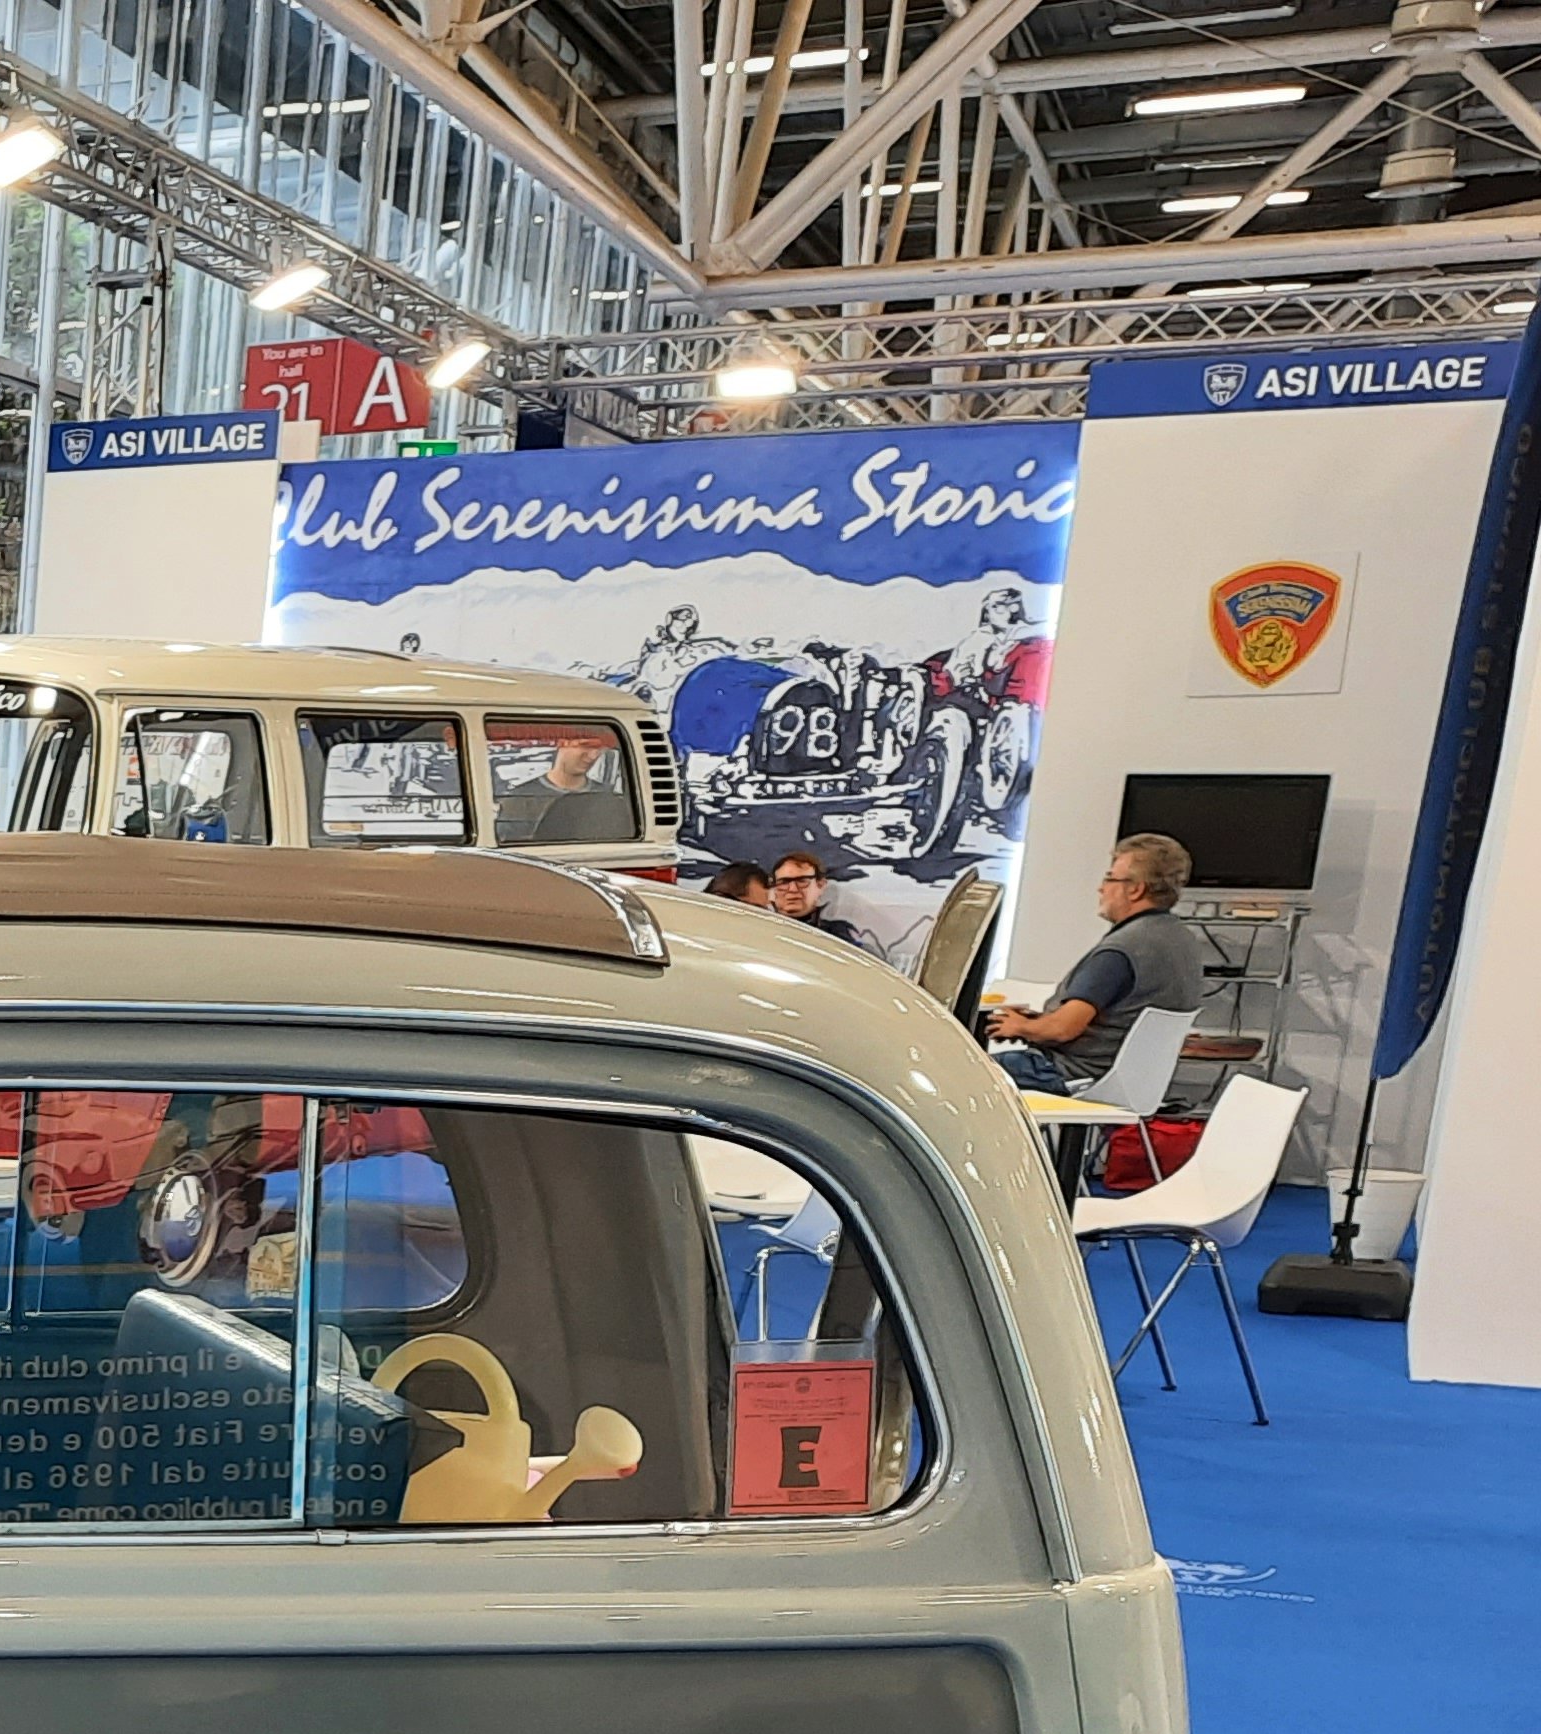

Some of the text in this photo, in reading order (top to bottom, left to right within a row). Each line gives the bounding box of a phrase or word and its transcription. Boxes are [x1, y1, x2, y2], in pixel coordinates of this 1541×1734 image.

[261, 344, 325, 361] You are in
[278, 363, 305, 378] hall
[352, 355, 408, 428] A
[1254, 356, 1487, 399] ASI VILLAGE
[100, 423, 267, 459] ASI VILLAGE
[414, 466, 823, 555] Serenissima
[771, 704, 840, 758] 98
[778, 1425, 822, 1489] E
